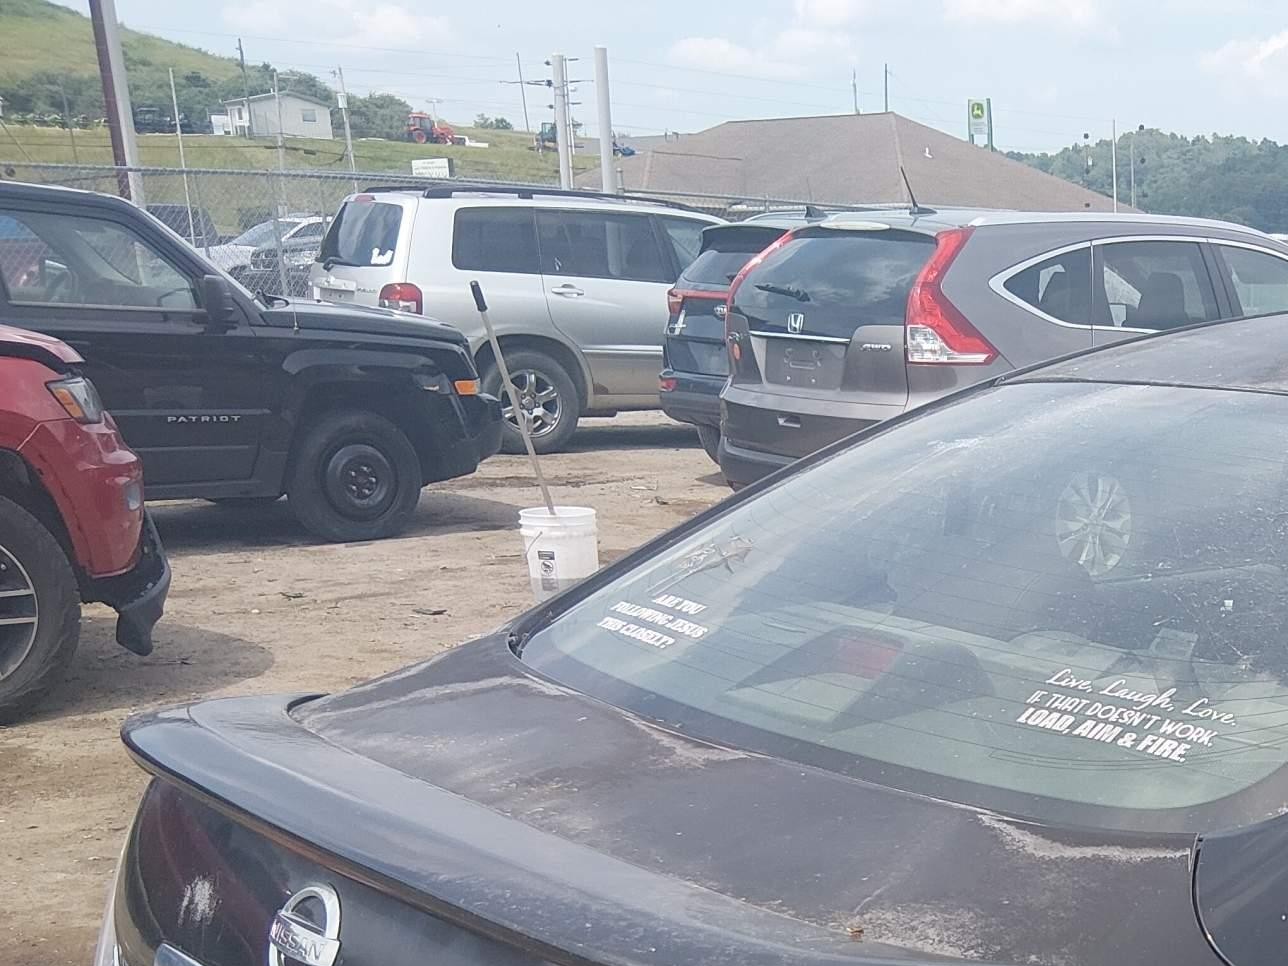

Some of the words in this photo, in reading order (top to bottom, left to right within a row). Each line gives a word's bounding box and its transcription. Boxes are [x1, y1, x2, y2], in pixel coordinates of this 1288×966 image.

[167, 415, 241, 423] PATRIOT
[610, 601, 674, 625] FOLLOWING
[664, 618, 708, 638] JESUS
[675, 599, 707, 615] YOU
[597, 617, 627, 631] THIS
[619, 623, 675, 649] CLOSELY?
[1045, 668, 1094, 694] Live,
[1099, 679, 1177, 712] Laugh,
[1026, 690, 1048, 704] IF
[1045, 693, 1090, 714] THAT
[1085, 703, 1161, 730] DOESN'T
[1016, 707, 1076, 734] LOAD,
[1073, 720, 1125, 744] AIM
[1117, 732, 1138, 748] &
[1136, 735, 1192, 763] FIRE.
[270, 918, 326, 961] NISSAN
